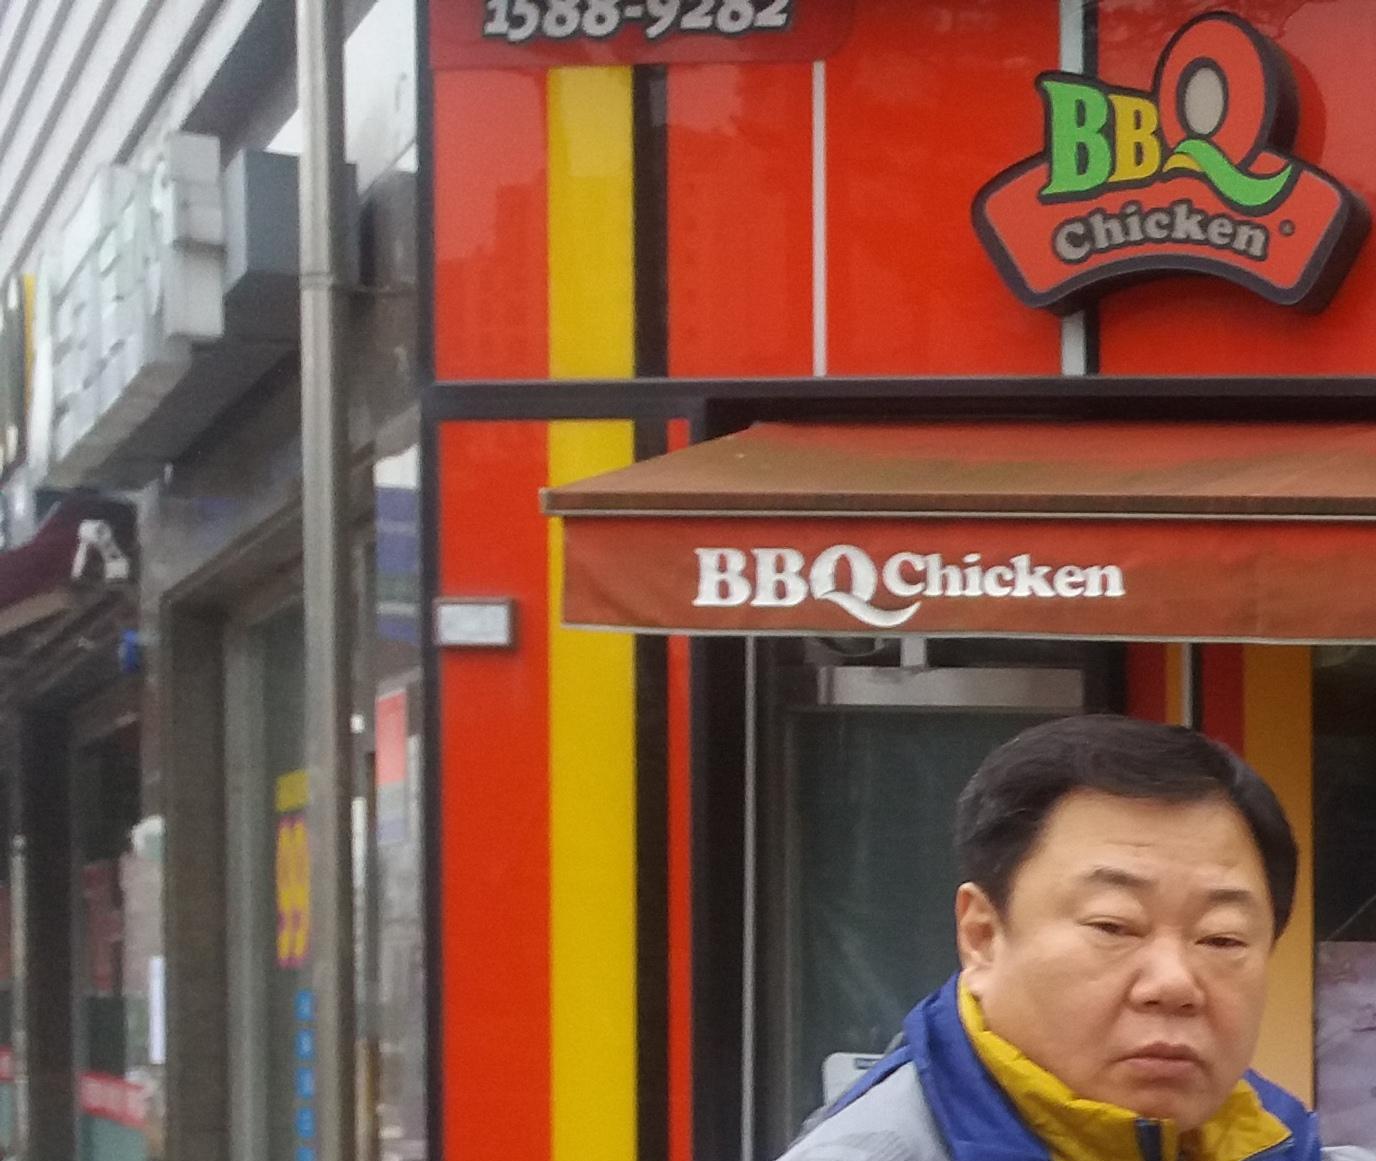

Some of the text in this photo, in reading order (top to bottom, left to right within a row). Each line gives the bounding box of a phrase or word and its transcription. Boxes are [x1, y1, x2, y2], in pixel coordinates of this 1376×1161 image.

[1040, 19, 1292, 207] BBQ
[1056, 202, 1267, 261] Chicken
[692, 545, 1125, 630] BBQ Chicken
